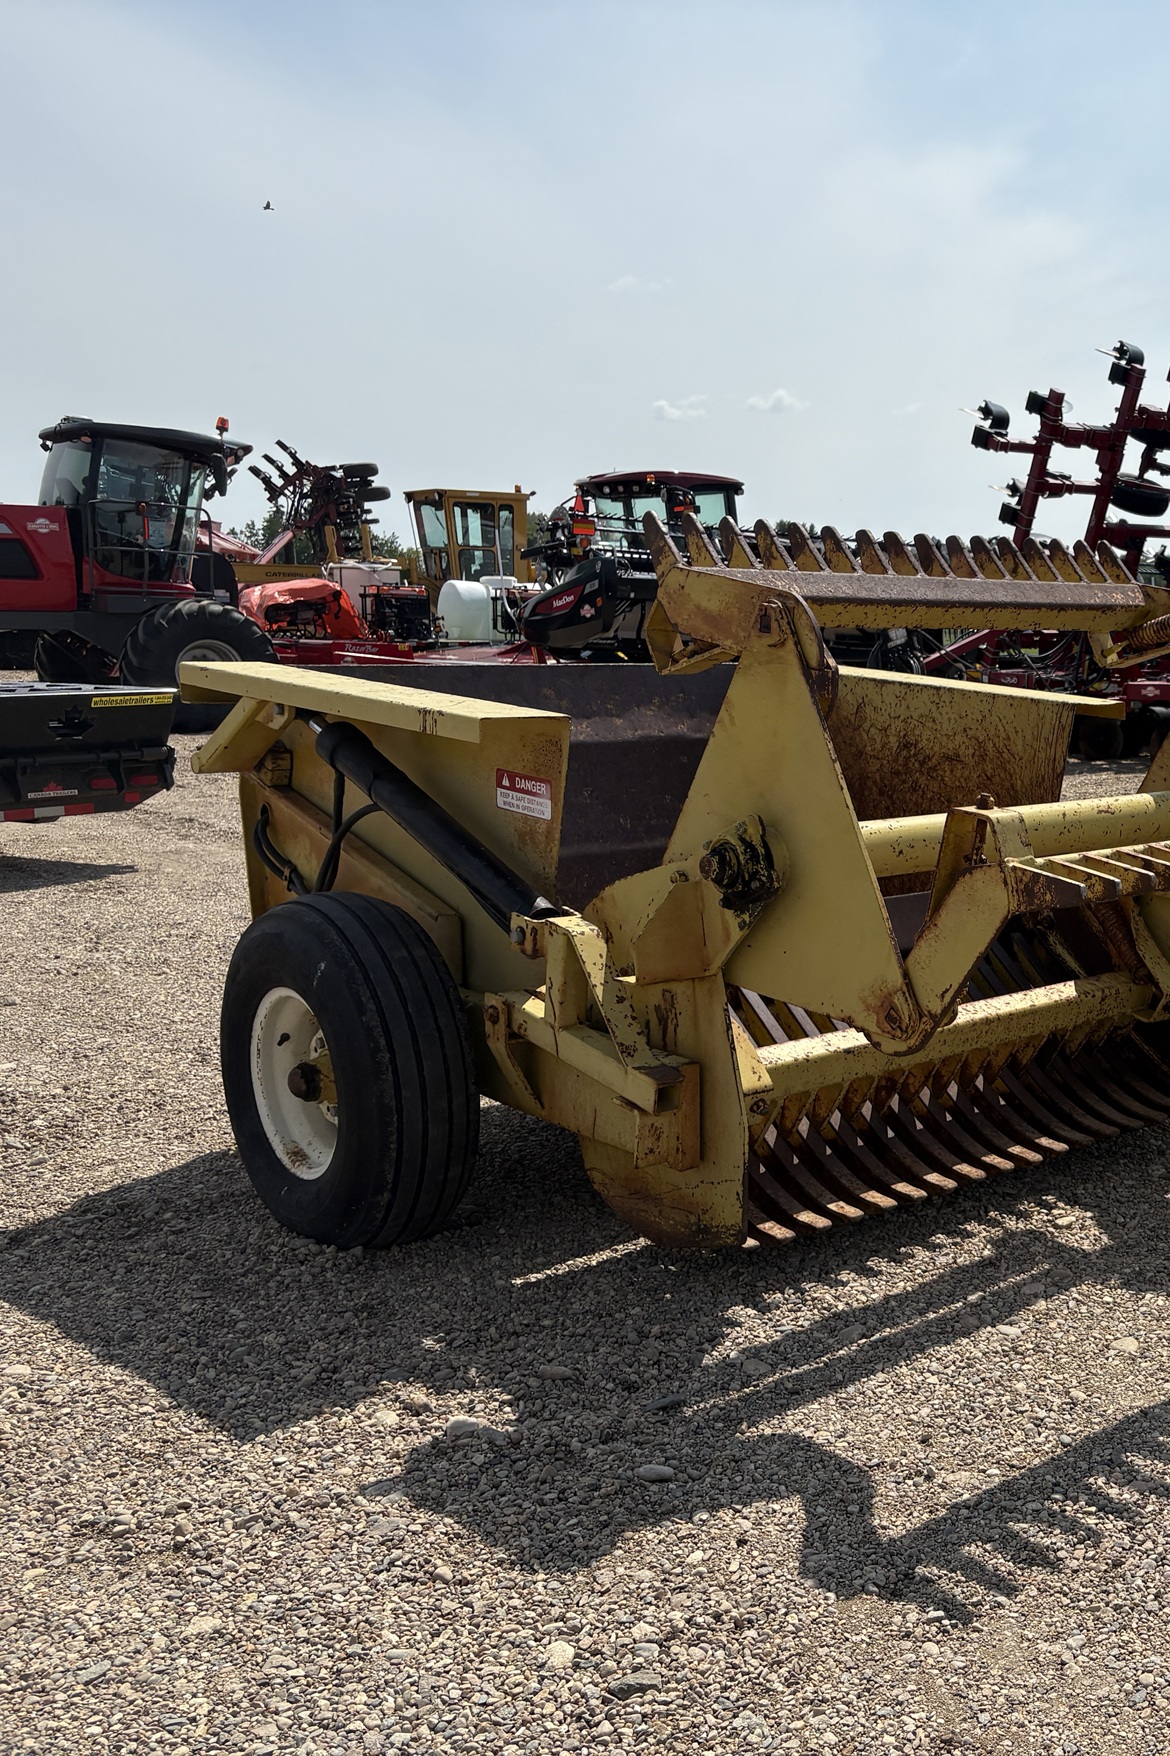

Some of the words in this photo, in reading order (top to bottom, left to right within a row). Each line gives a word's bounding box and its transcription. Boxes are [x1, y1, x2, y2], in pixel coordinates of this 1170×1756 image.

[553, 595, 575, 608] MacDon
[93, 696, 154, 707] wholesaletrailers
[515, 777, 547, 794] DANGER
[500, 791, 510, 799] KEEP
[515, 795, 526, 804] SAFE
[503, 800, 515, 808] WHEN
[521, 805, 545, 816] OPERATION
